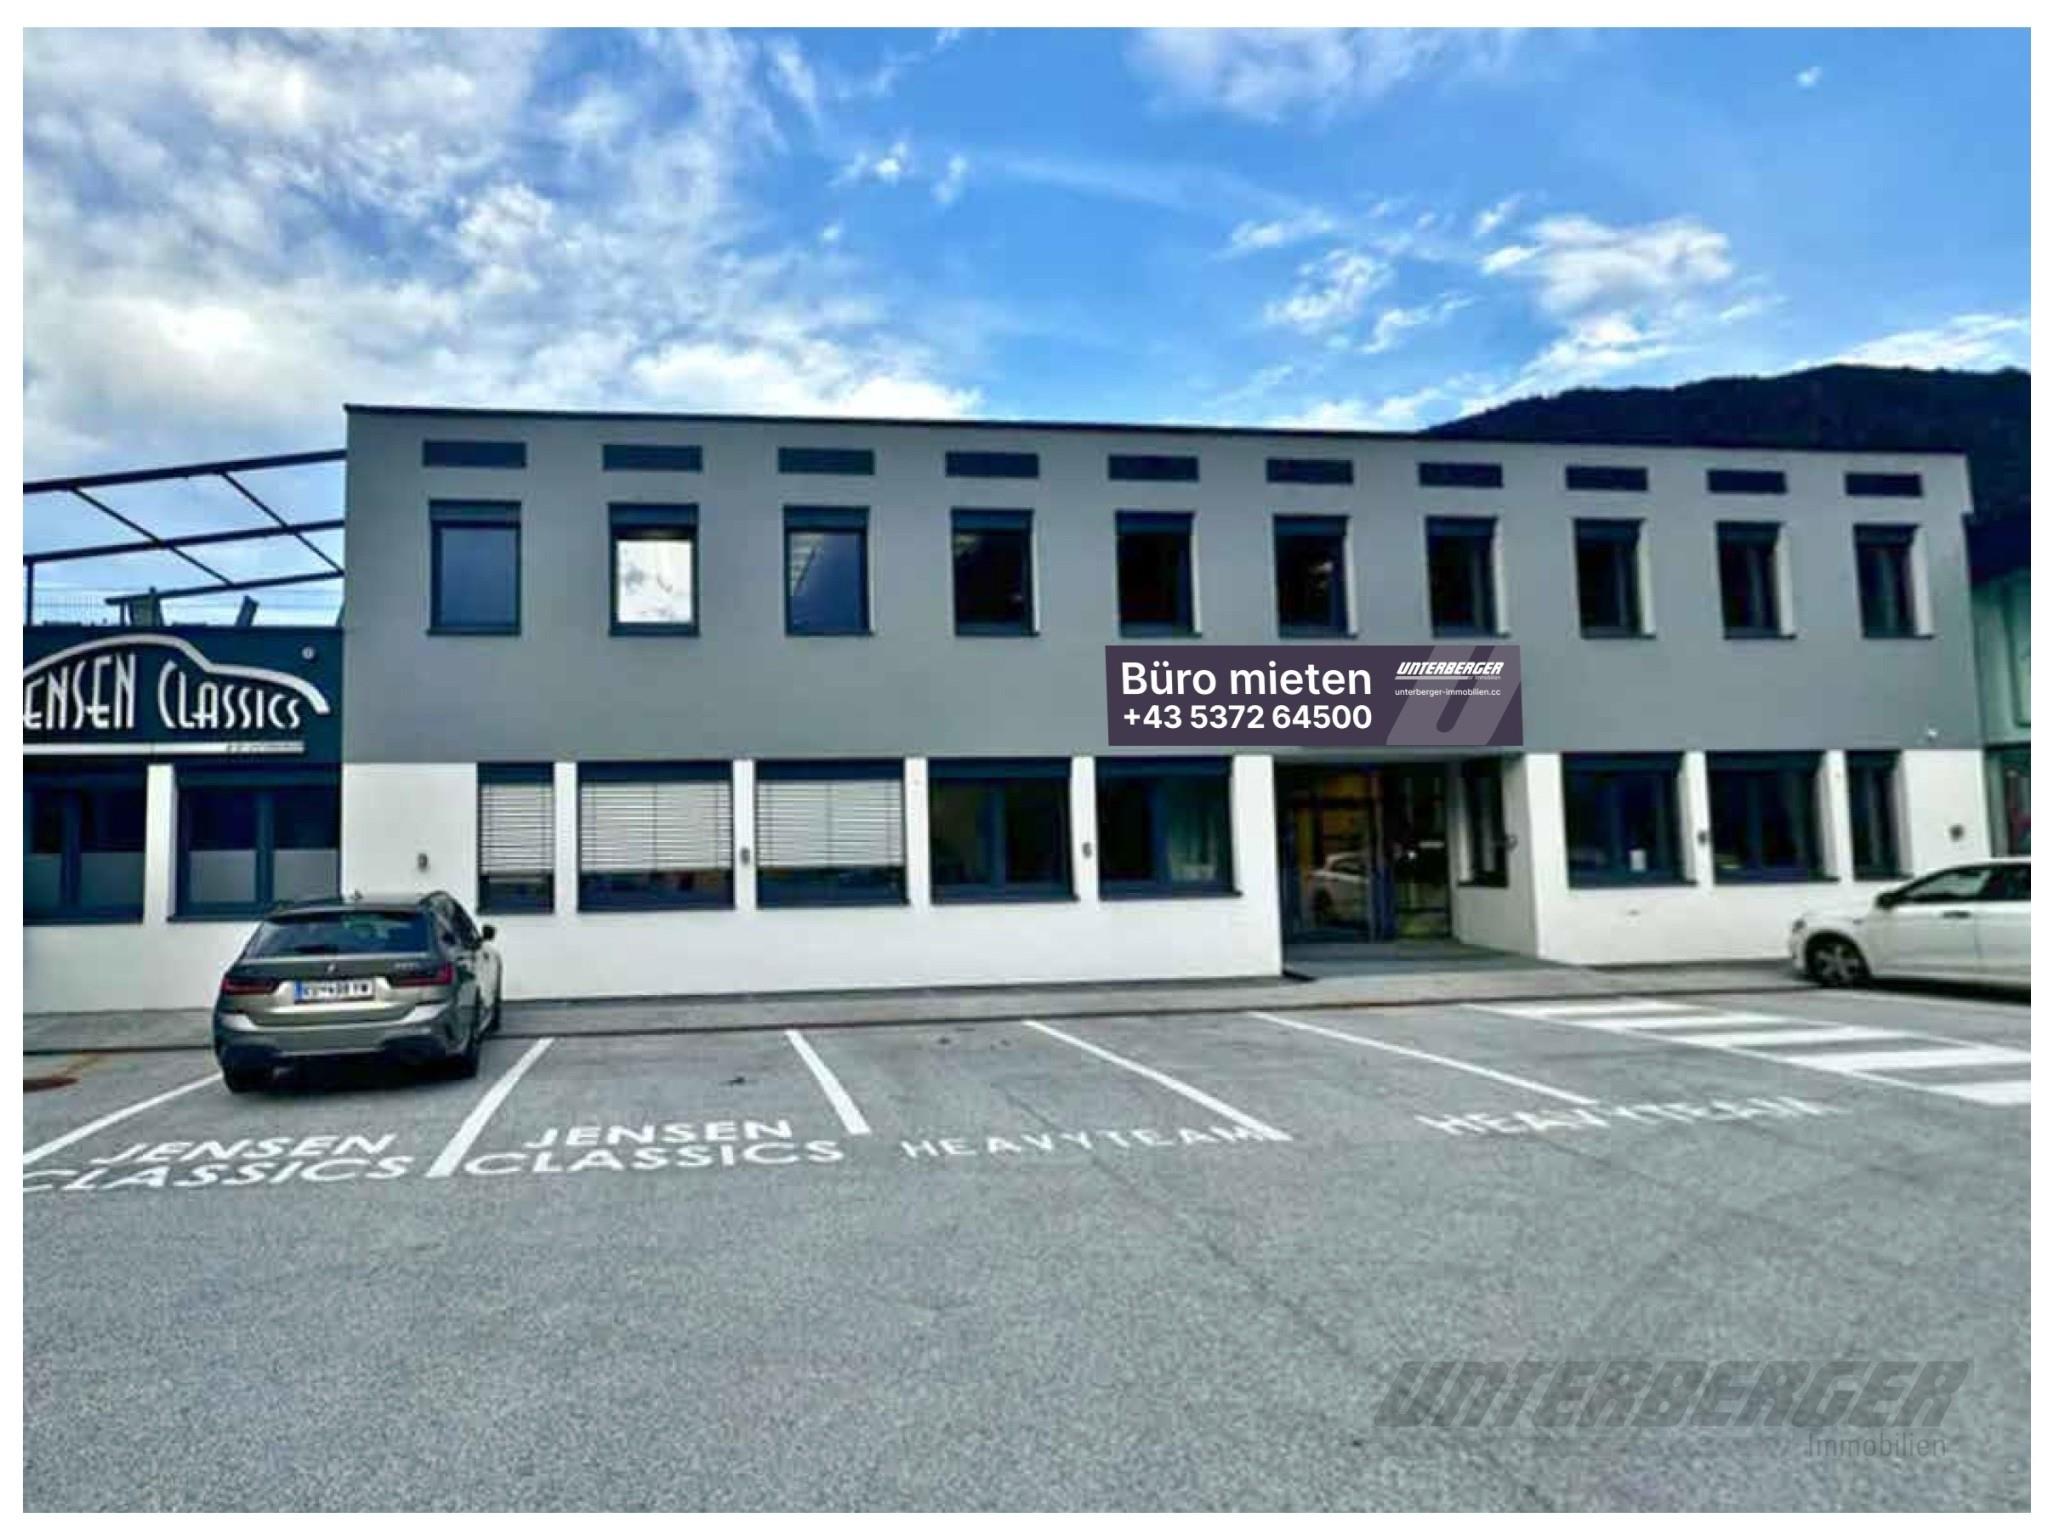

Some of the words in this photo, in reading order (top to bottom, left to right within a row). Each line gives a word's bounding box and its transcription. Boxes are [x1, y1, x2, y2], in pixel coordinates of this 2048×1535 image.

[1121, 660, 1217, 696] Büro
[1230, 660, 1372, 696] mieten
[1396, 661, 1504, 675] UNTERBERGER
[23, 653, 136, 730] ENSEN
[1395, 688, 1501, 698] unterberger-immobilien.cc
[1123, 704, 1183, 729] +43
[1190, 704, 1265, 729] 5372
[1271, 704, 1373, 729] 64500
[91, 1133, 398, 1164] JENSEN
[523, 1119, 793, 1149] JENSEN
[901, 1126, 1272, 1158] HEAVYTEAM
[463, 1139, 845, 1175] CLASSICS
[23, 1155, 414, 1193] CLASSICS
